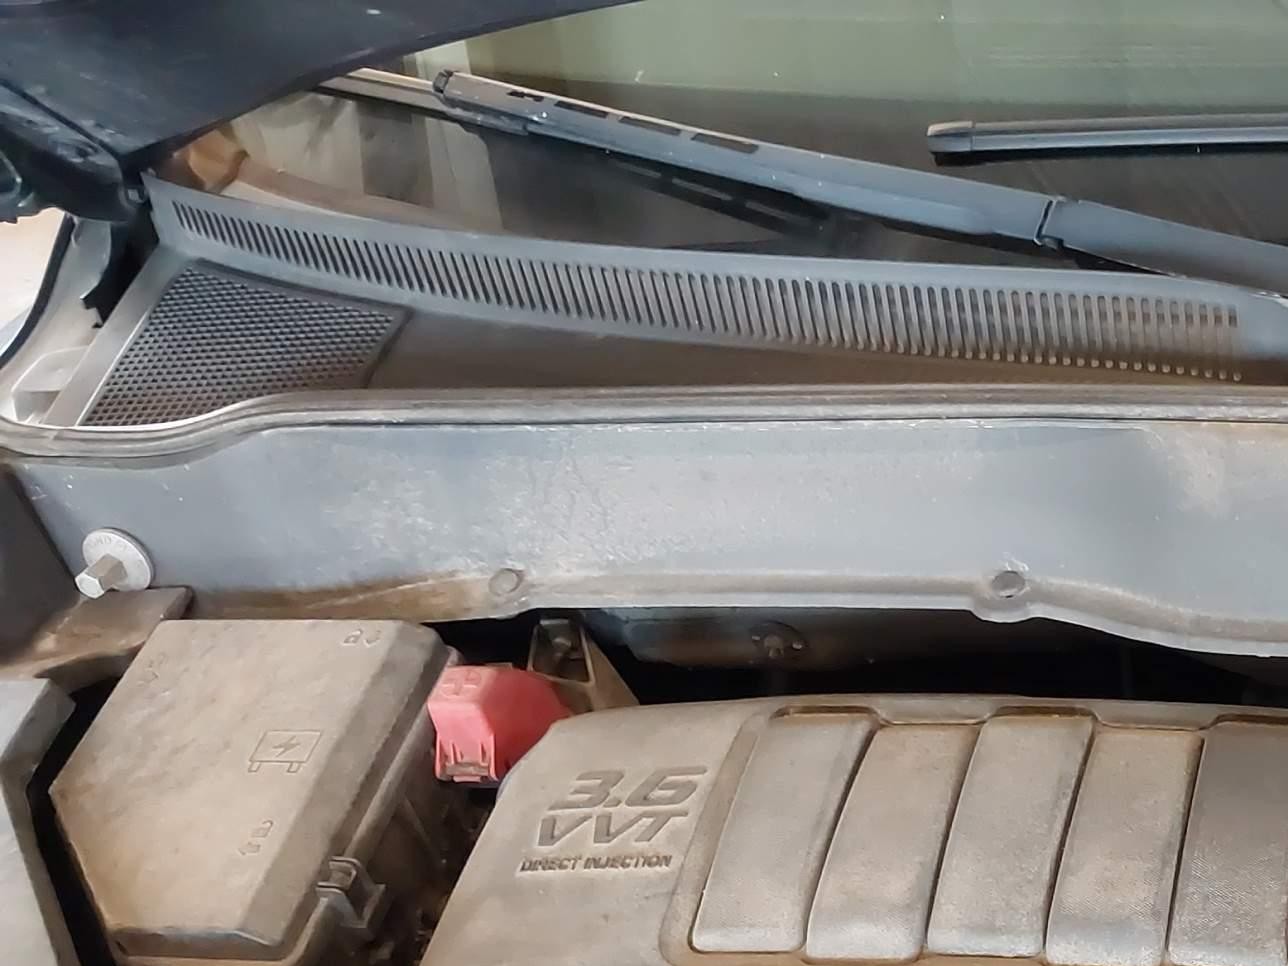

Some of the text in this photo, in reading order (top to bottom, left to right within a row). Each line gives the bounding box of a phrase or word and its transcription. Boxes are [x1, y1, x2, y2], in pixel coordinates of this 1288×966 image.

[548, 765, 709, 811] 3.6
[537, 810, 688, 847] VVT
[520, 854, 673, 872] DIRECT INJECTION
